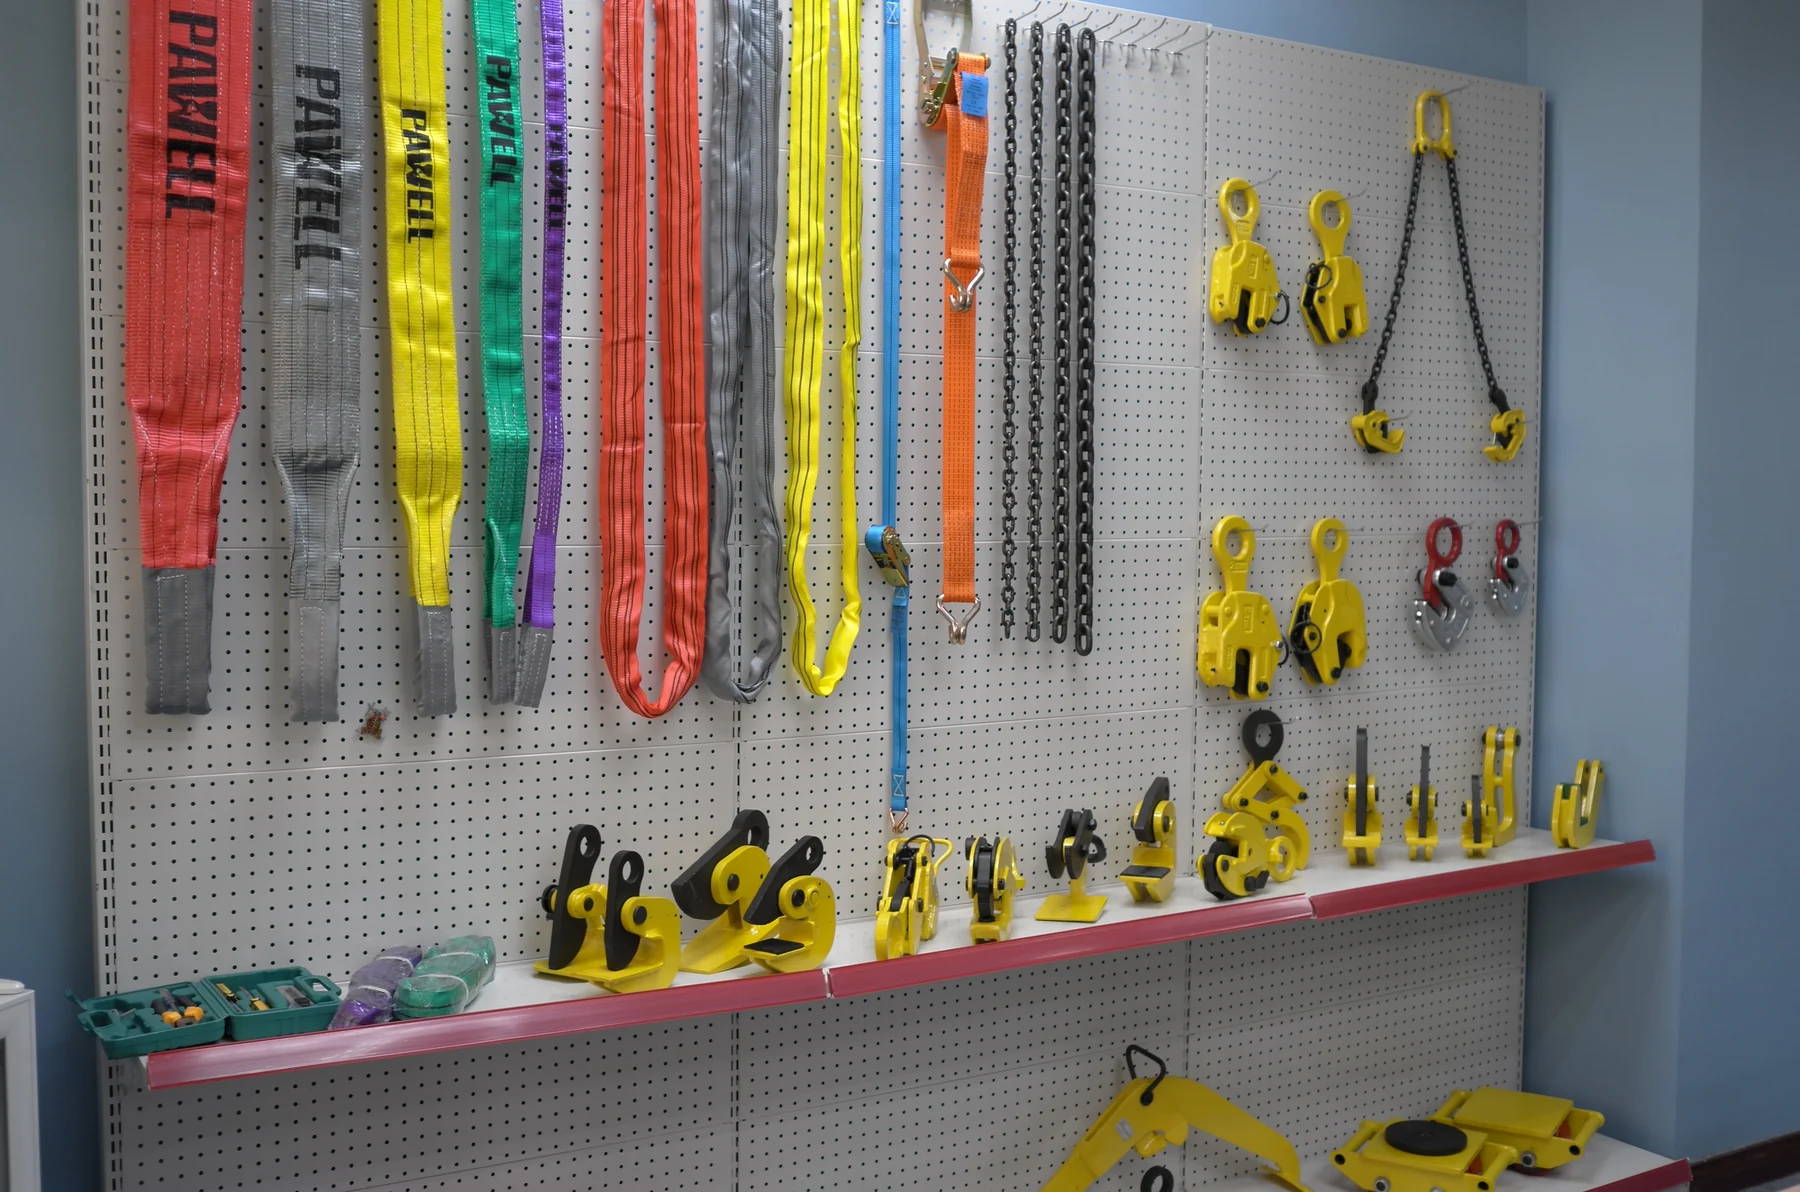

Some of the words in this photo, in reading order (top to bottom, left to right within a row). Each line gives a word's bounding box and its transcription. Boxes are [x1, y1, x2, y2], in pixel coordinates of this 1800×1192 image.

[166, 10, 217, 218] PAWELL
[294, 64, 341, 270] PAWELL
[402, 109, 434, 244] PAWELL
[486, 55, 517, 188] PAWELL
[549, 124, 564, 230] PAWELL
